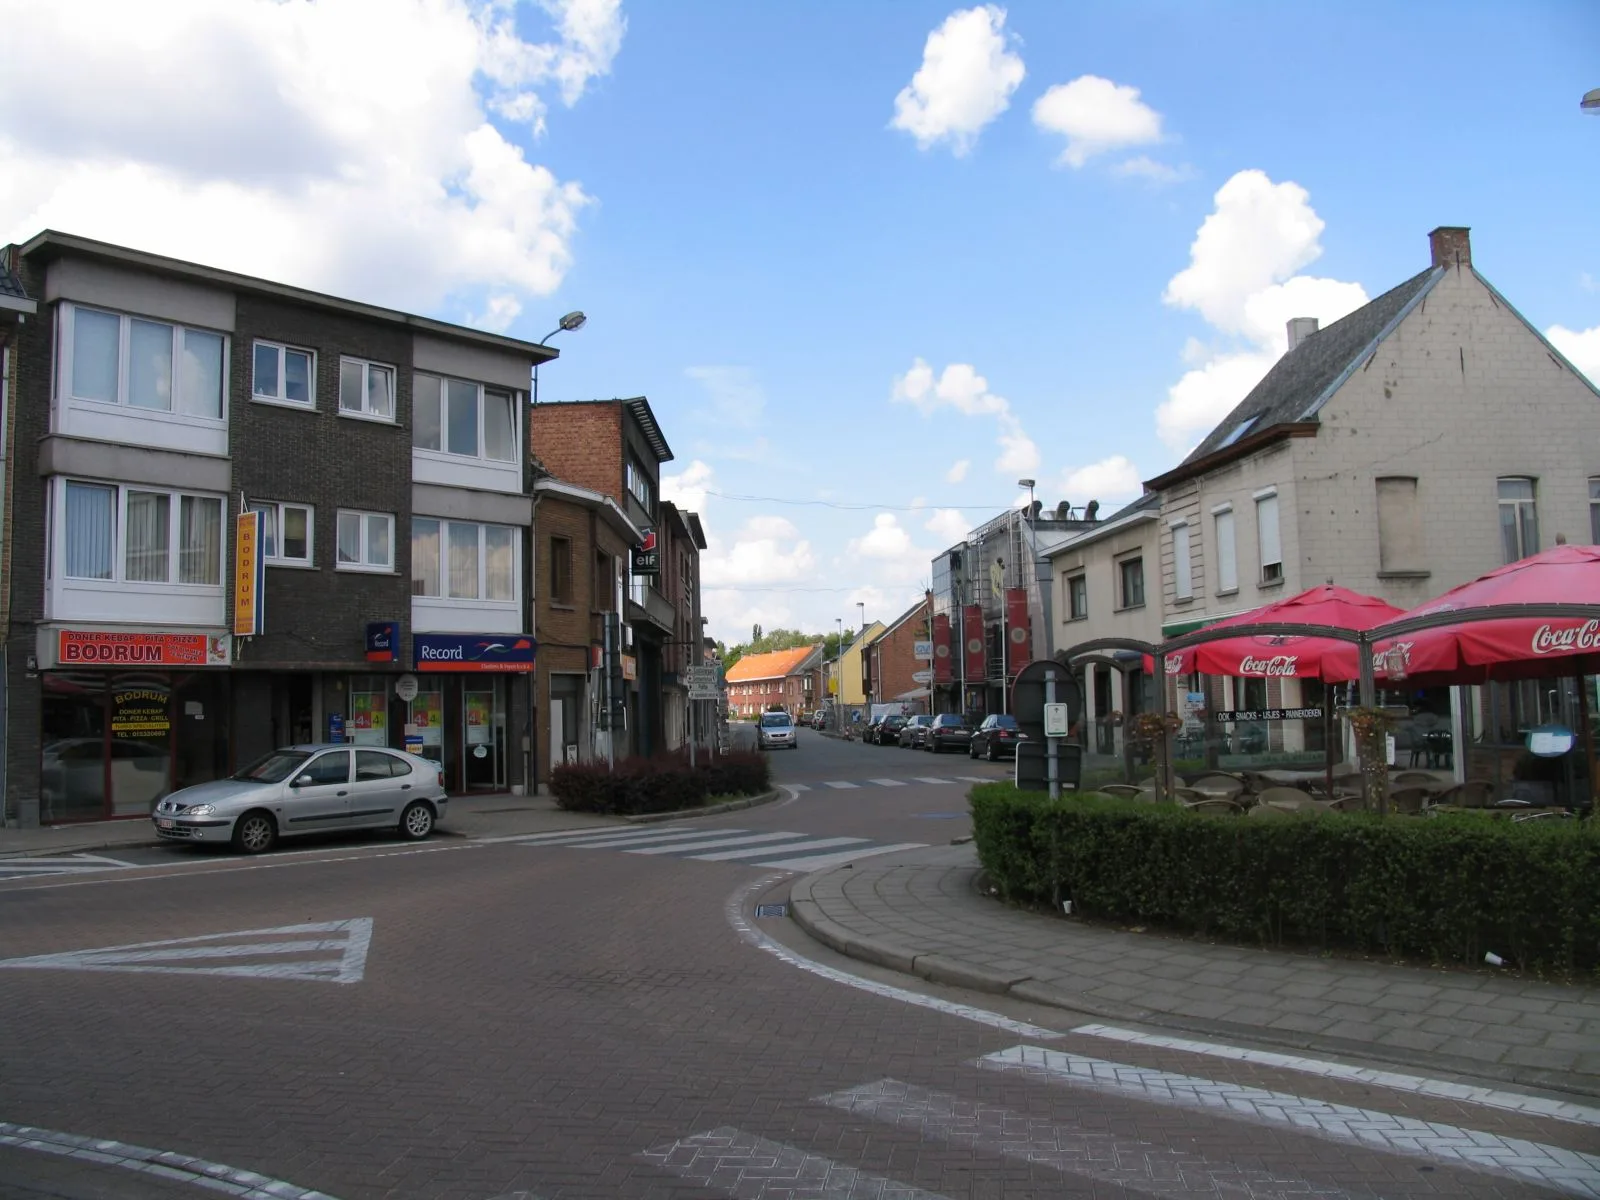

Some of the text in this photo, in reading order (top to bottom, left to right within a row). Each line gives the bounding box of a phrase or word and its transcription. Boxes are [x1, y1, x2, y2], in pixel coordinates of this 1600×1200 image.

[636, 555, 655, 566] elf
[241, 533, 251, 607] BODRUM
[104, 634, 136, 642] KEBAP
[374, 639, 389, 647] Record
[65, 643, 163, 662] BODRUM
[421, 645, 463, 660] Record
[1239, 655, 1298, 676] Coca-Cola
[115, 690, 168, 704] BODRUM
[1217, 712, 1230, 722] OOK
[1235, 711, 1257, 721] SNACKS
[1285, 709, 1322, 718] PANNEKOEKEN
